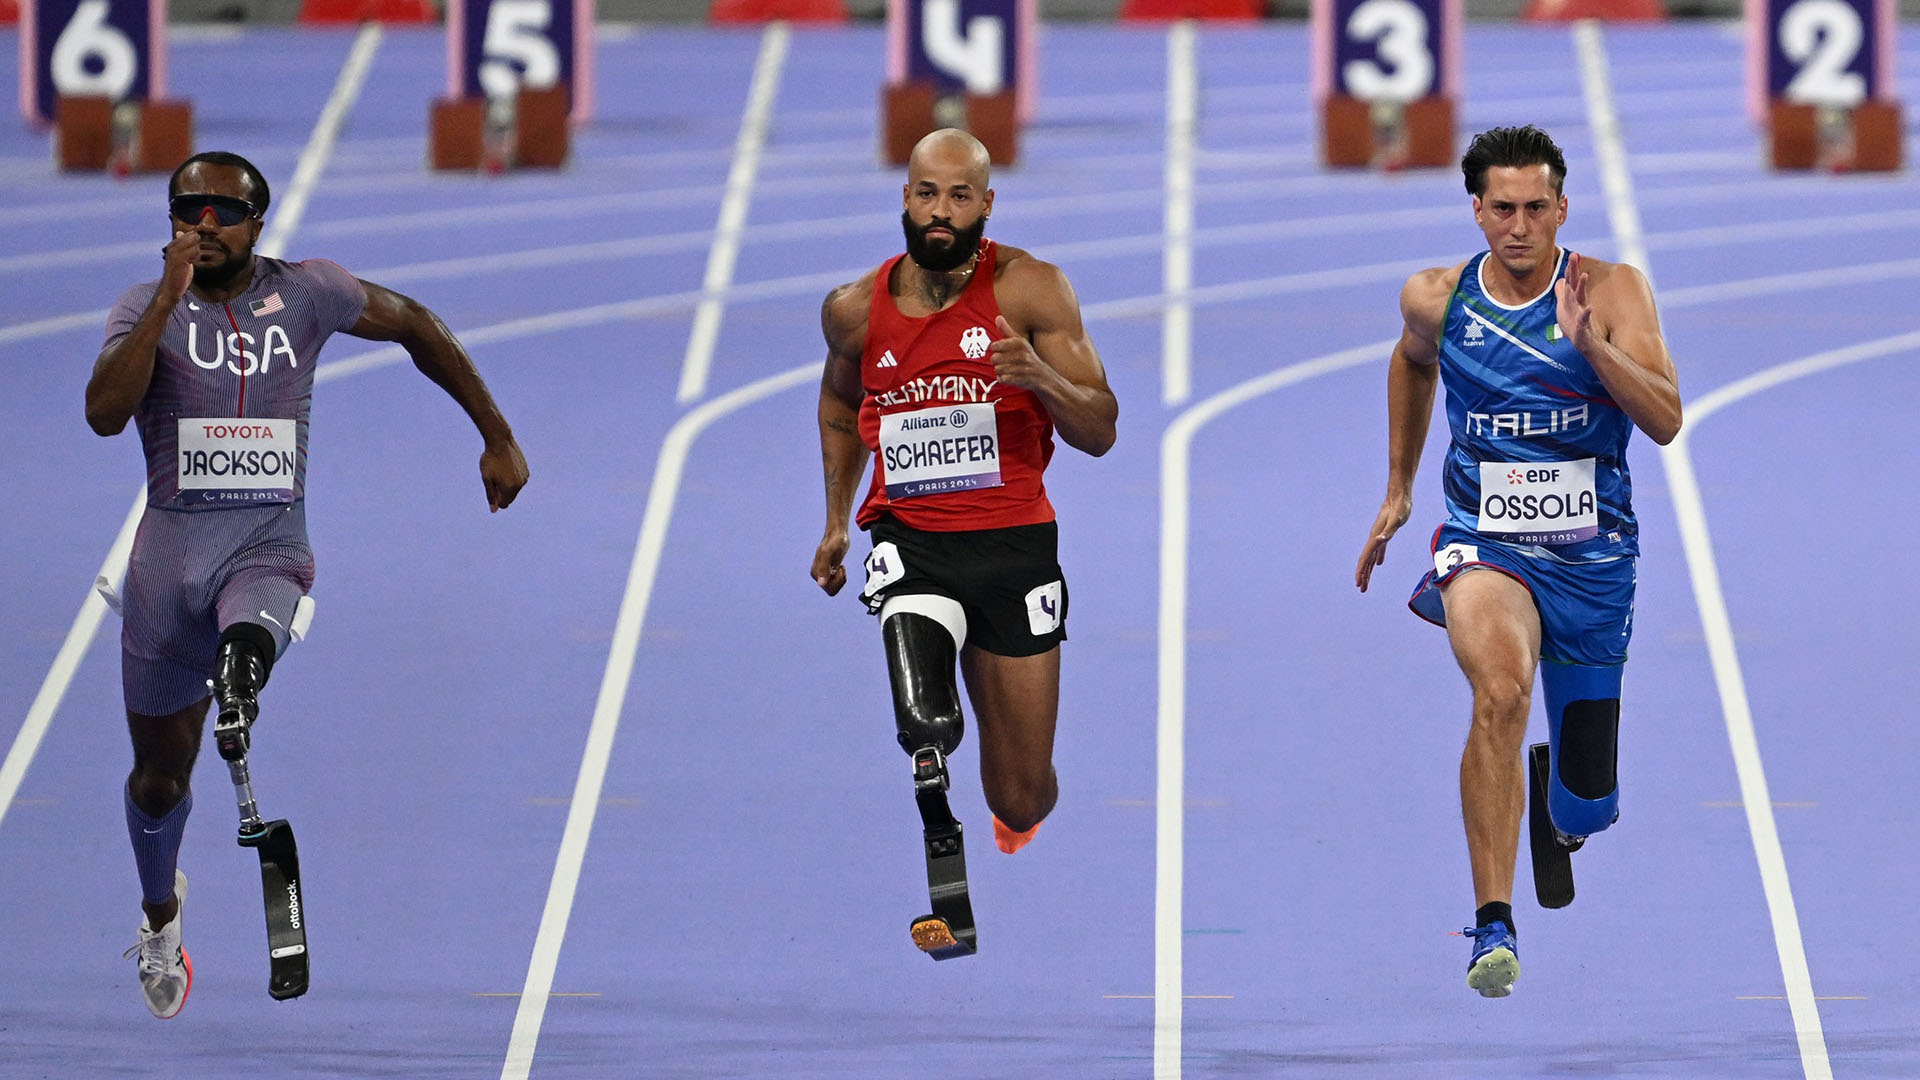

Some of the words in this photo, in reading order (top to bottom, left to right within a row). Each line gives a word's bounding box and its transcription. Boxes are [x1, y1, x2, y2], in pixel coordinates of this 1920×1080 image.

[51, 0, 138, 100] 6
[477, 0, 561, 97] 5
[922, 0, 1005, 96] 4
[1342, 0, 1435, 103] 3
[1777, 0, 1868, 104] 2
[188, 322, 297, 377] USA
[875, 376, 999, 407] GERMANY
[203, 425, 273, 439] TOYOTA
[901, 416, 947, 431] Allianz
[1465, 403, 1589, 436] ITALIA
[182, 450, 295, 476] JACKSON
[885, 435, 996, 471] SCHAEFER
[219, 492, 249, 500] PARIS
[252, 492, 279, 500] 2024
[919, 481, 947, 492] PARIS
[950, 479, 977, 488] 2024
[1485, 490, 1594, 520] OSSOLA
[1519, 535, 1549, 543] PARIS
[1551, 533, 1577, 542] 2024
[872, 556, 889, 575] 4
[1446, 549, 1464, 570] 3
[1040, 594, 1056, 621] 4
